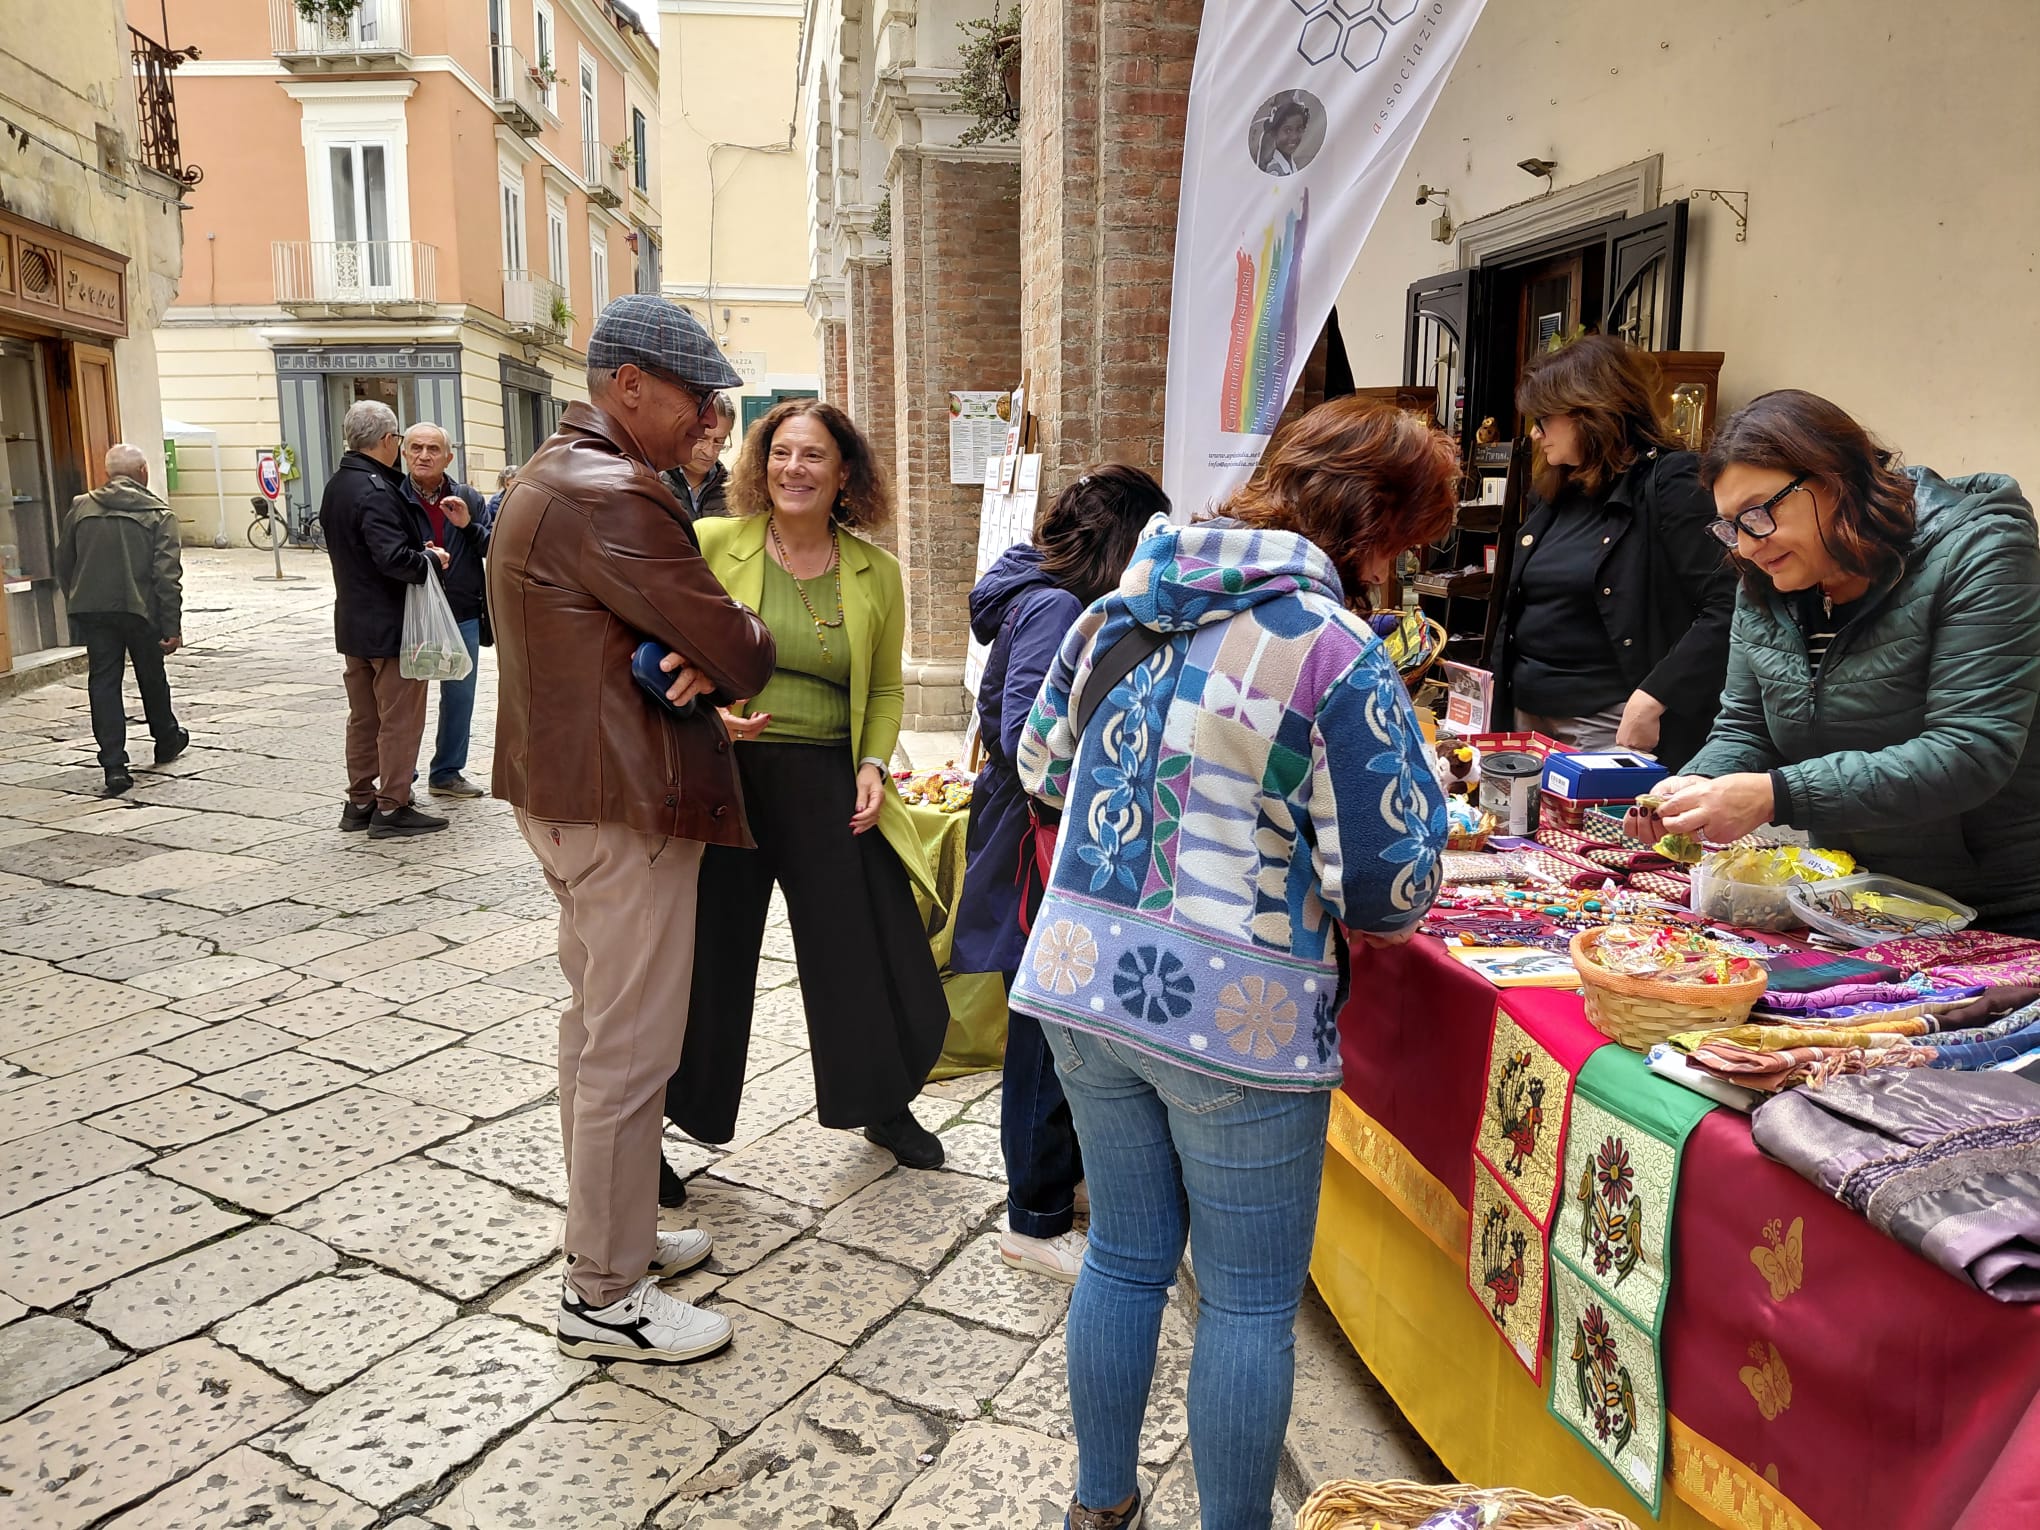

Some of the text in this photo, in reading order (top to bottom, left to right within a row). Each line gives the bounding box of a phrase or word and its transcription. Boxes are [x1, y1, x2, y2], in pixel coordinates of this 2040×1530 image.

[1259, 268, 1279, 328] bisognosi
[278, 355, 377, 368] FARMACIA
[736, 367, 756, 375] ENTO
[1255, 357, 1267, 376] dei
[1263, 332, 1286, 431] del Tamil Nadu
[1225, 394, 1238, 430] Come
